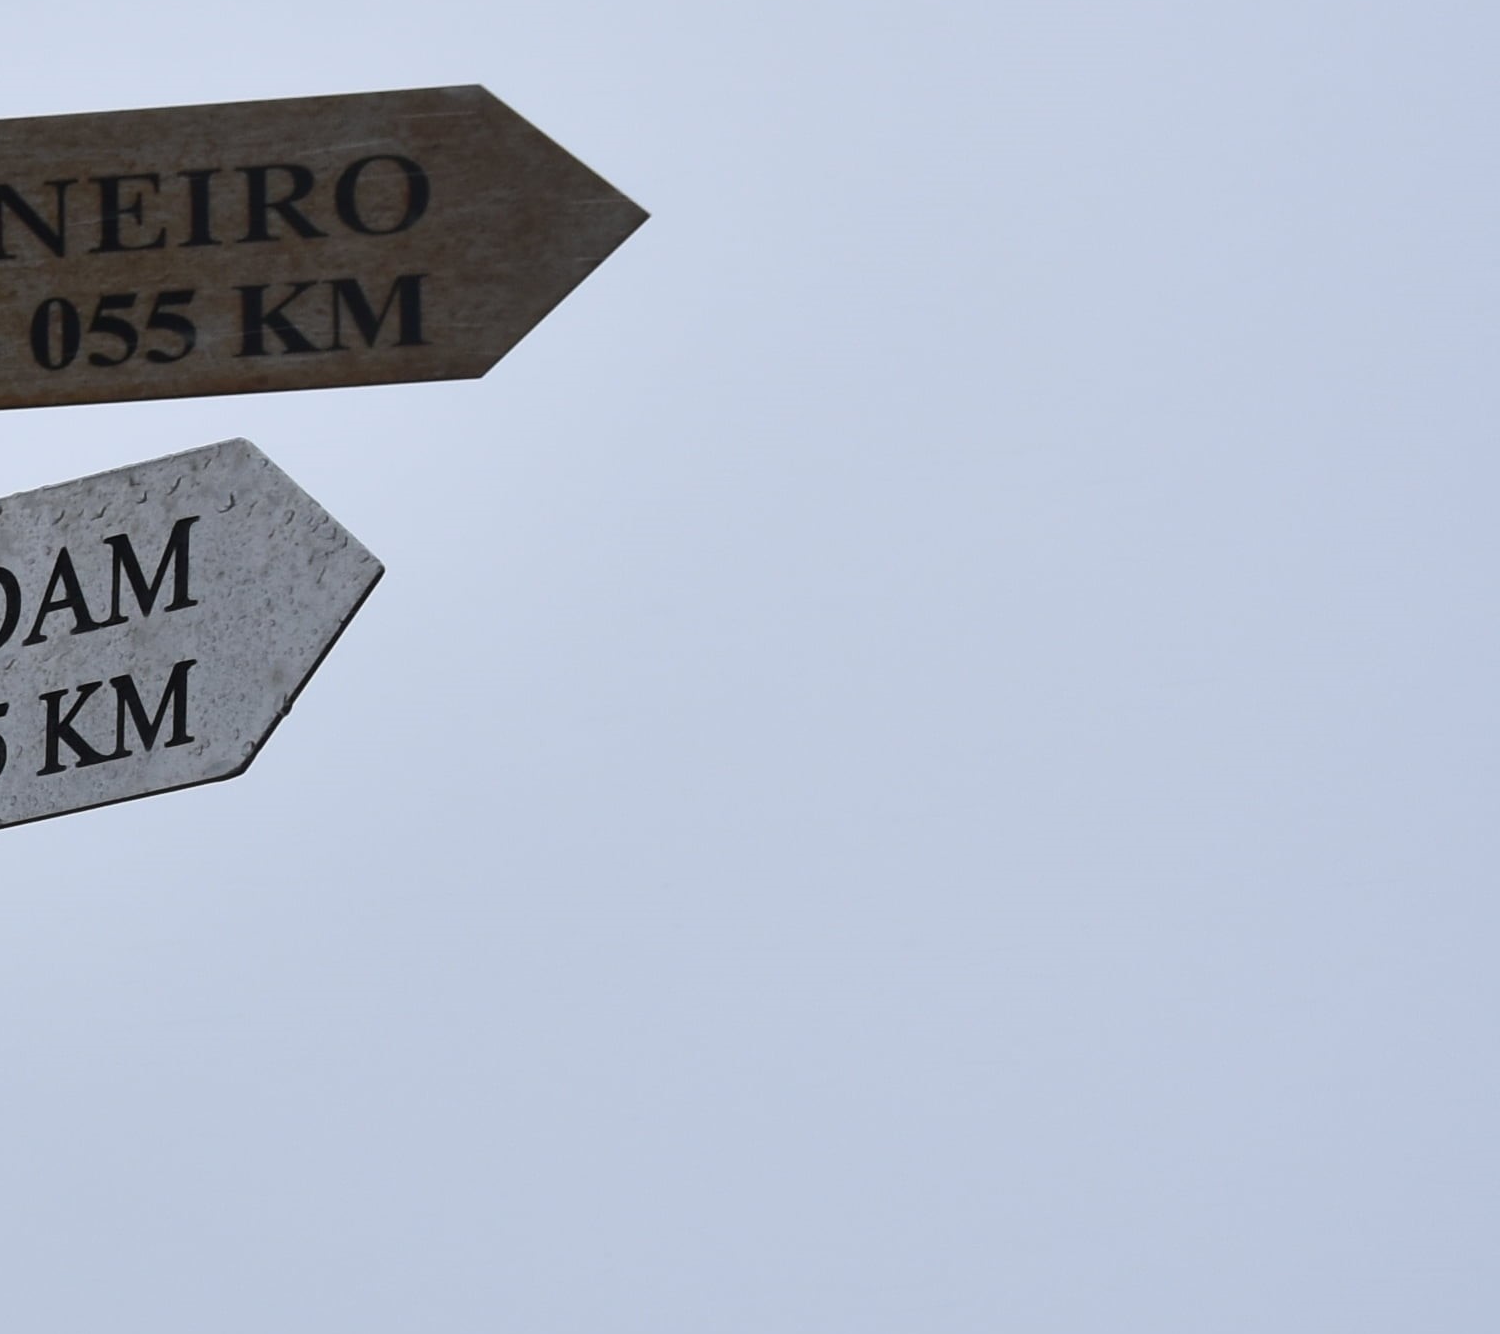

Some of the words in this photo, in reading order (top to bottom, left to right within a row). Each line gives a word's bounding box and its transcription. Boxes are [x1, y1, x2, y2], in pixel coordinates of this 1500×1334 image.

[26, 286, 198, 373] 055
[230, 271, 434, 359] KM
[35, 658, 198, 778] KM
